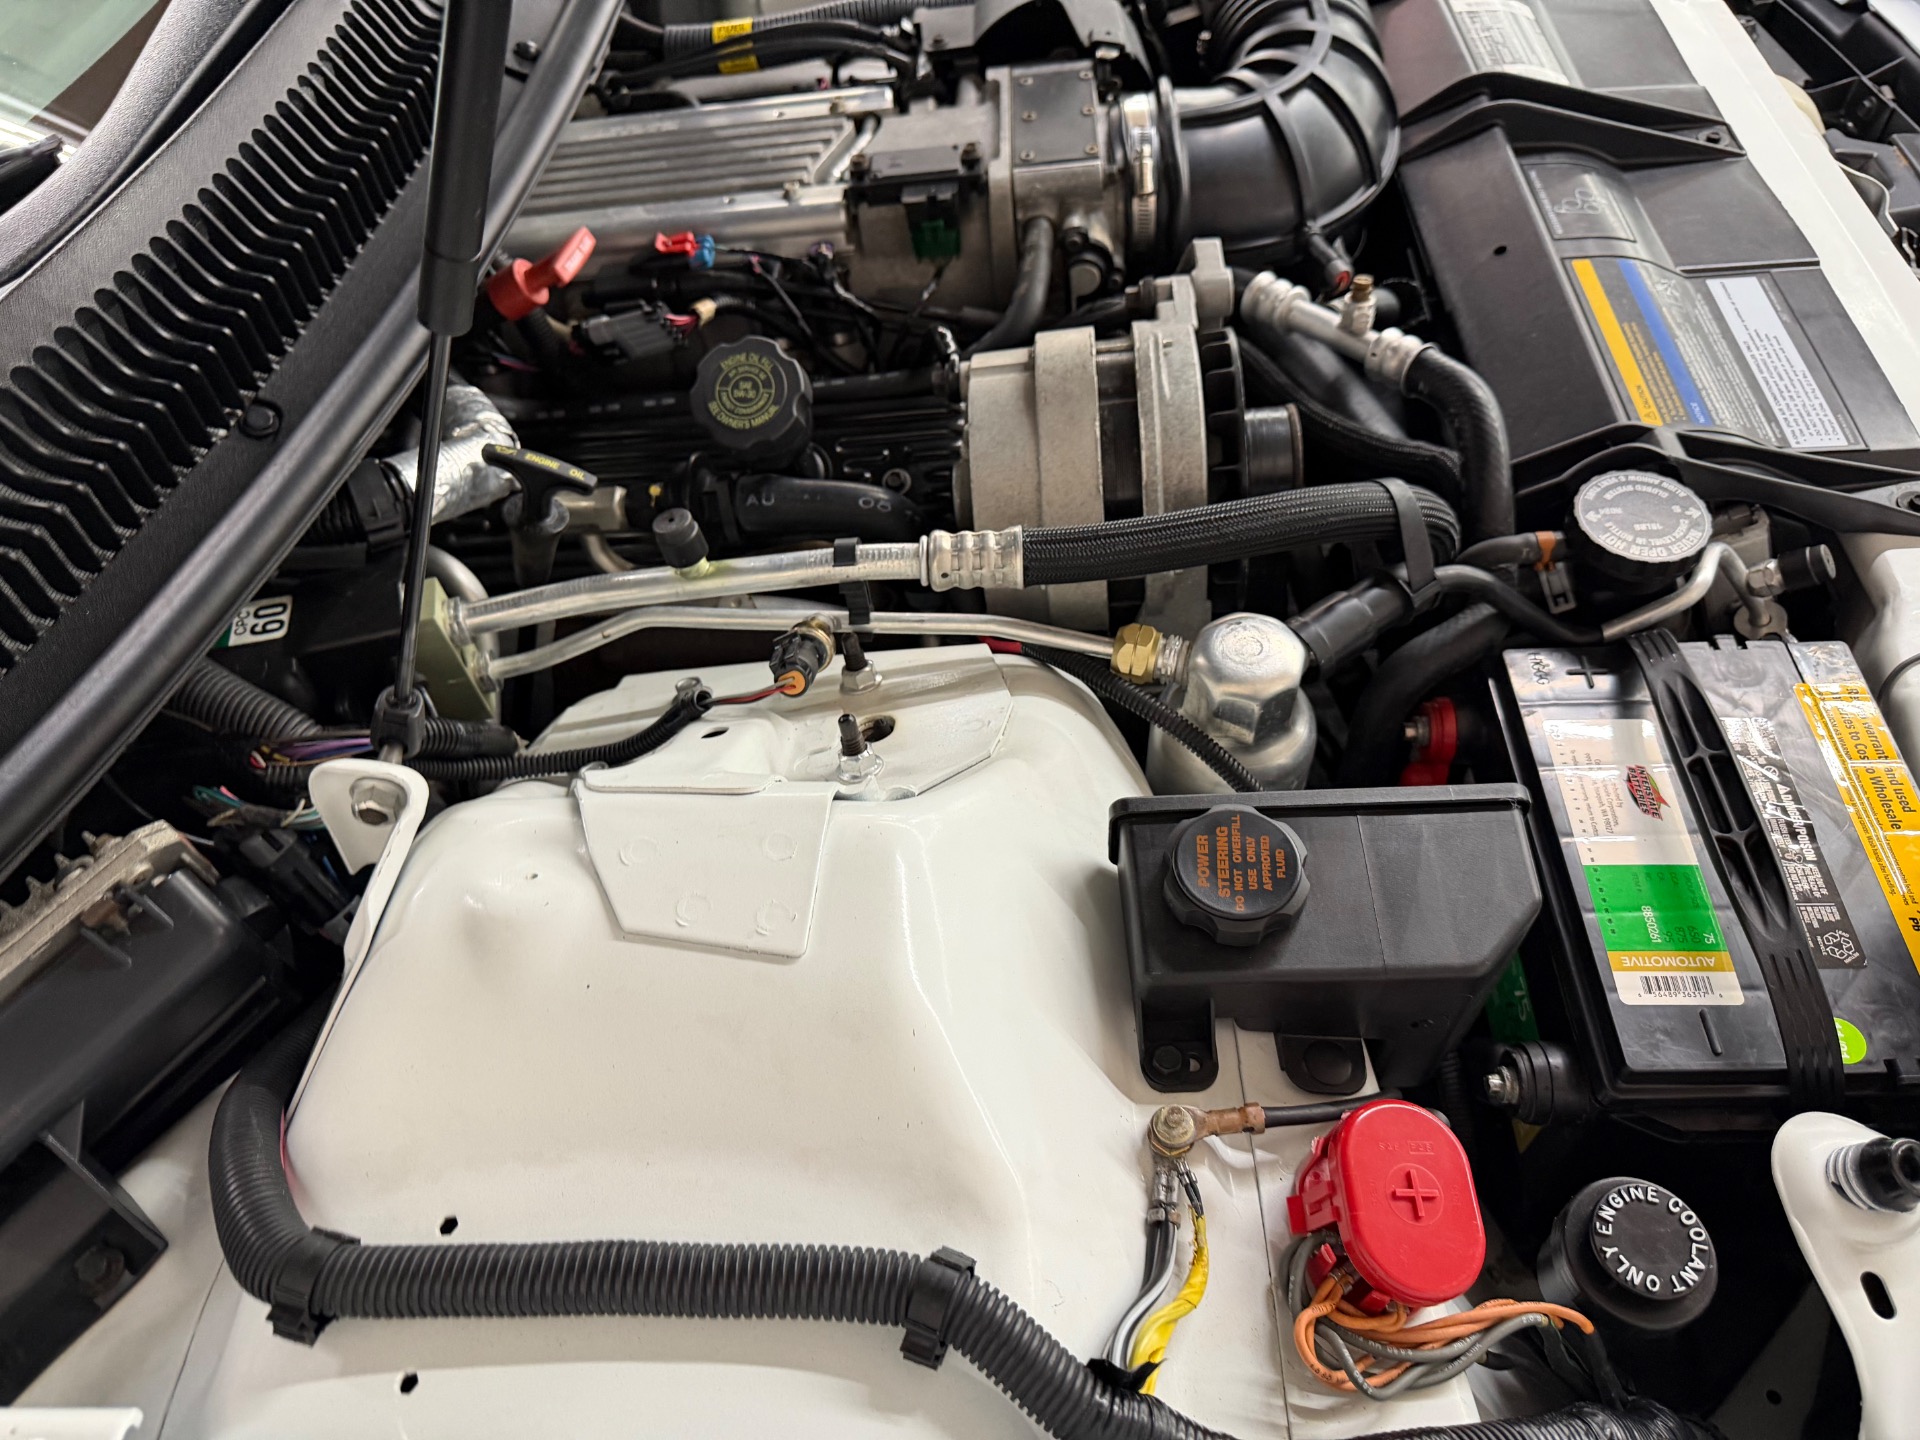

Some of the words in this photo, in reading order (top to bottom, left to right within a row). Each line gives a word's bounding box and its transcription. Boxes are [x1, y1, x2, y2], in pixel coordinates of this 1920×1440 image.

[749, 353, 761, 364] OIL
[525, 453, 560, 470] ENGINE
[569, 468, 585, 480] OIL
[1599, 532, 1626, 549] HOT
[1629, 545, 1667, 557] OPEN
[1669, 528, 1702, 555] NEVER
[250, 603, 288, 636] 60
[1626, 766, 1649, 813] BATTERIES
[1636, 766, 1661, 818] INTERSTATE
[1848, 732, 1861, 740] to
[1869, 777, 1903, 828] Wholesale
[1883, 767, 1901, 785] and
[1893, 789, 1915, 811] used
[1600, 809, 1607, 817] WA
[1231, 814, 1242, 863] OVERFILL
[1780, 795, 1817, 861] DANGER/POISON
[1196, 835, 1211, 888] POWER
[1216, 826, 1231, 898] STEERING
[1246, 836, 1257, 863] ONLY
[1260, 835, 1273, 891] APPROVED
[1276, 849, 1286, 879] FLUID
[1790, 873, 1799, 882] NOT
[1234, 869, 1244, 891] NOT
[1248, 869, 1258, 890] USE
[1882, 875, 1897, 895] handling.
[1235, 896, 1245, 912] DO
[1641, 906, 1660, 942] 8850261
[1662, 931, 1673, 942] 95
[1674, 927, 1687, 943] 875
[1687, 926, 1700, 943] 650
[1703, 933, 1714, 943] 75
[1816, 935, 1827, 955] RECYCLE
[1621, 955, 1715, 968] AUTOMOTIVE
[1596, 1186, 1660, 1236] ENGINE
[1668, 1197, 1709, 1293] COOLANT
[1601, 1246, 1660, 1292] ONLY
